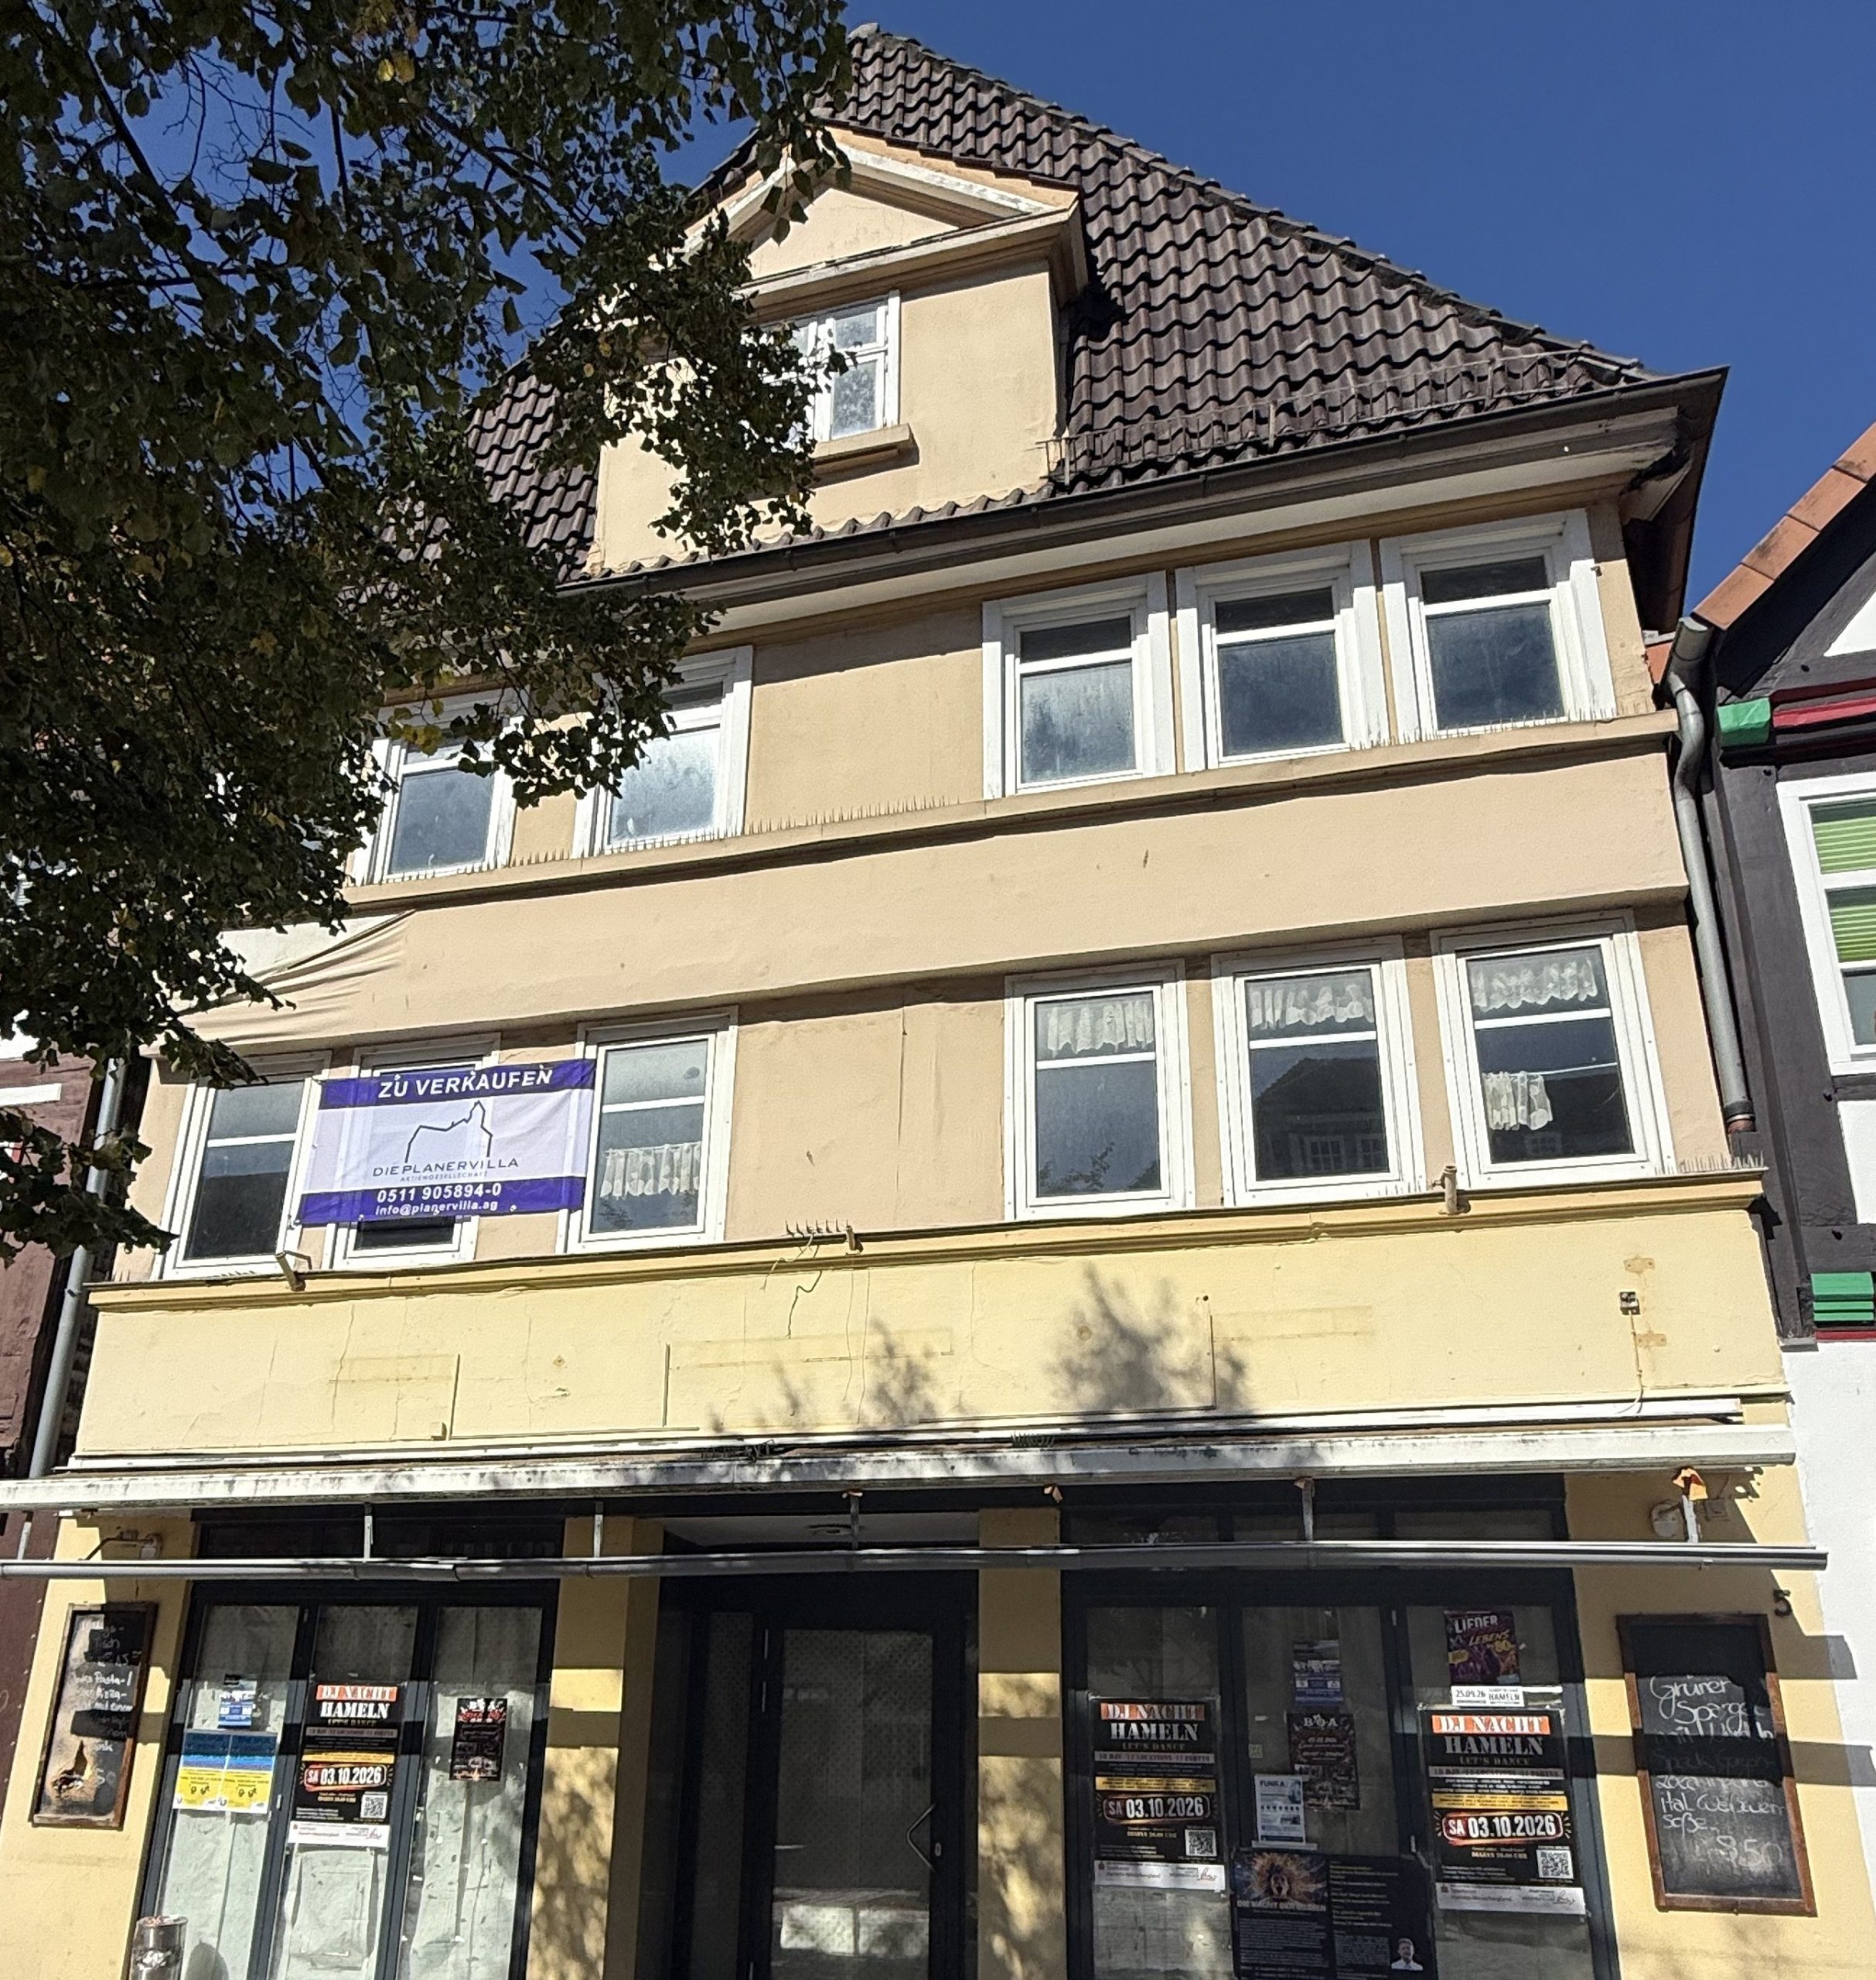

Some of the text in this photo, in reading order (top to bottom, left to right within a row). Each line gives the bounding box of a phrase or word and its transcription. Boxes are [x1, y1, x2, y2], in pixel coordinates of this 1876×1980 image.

[378, 1069, 553, 1098] ZU VERKAUFEN
[377, 1183, 502, 1203] 0511 905894-0
[375, 1200, 498, 1217] info@planervilla.ag
[1773, 1589, 1792, 1617] 5
[322, 1685, 391, 1701] DJ NACHT
[1650, 1674, 1731, 1719] Grüner
[320, 1702, 391, 1719] HAMELN
[1107, 1704, 1197, 1719] DJ NACHT
[1110, 1722, 1199, 1741] HAMELN
[1440, 1715, 1543, 1734] DJ NACHT
[1445, 1736, 1543, 1756] HAMELN
[307, 1766, 382, 1784] SA 03.10.2026
[1109, 1797, 1204, 1818] SA 03.10.2026
[1448, 1814, 1557, 1838] SA 03.10.2026
